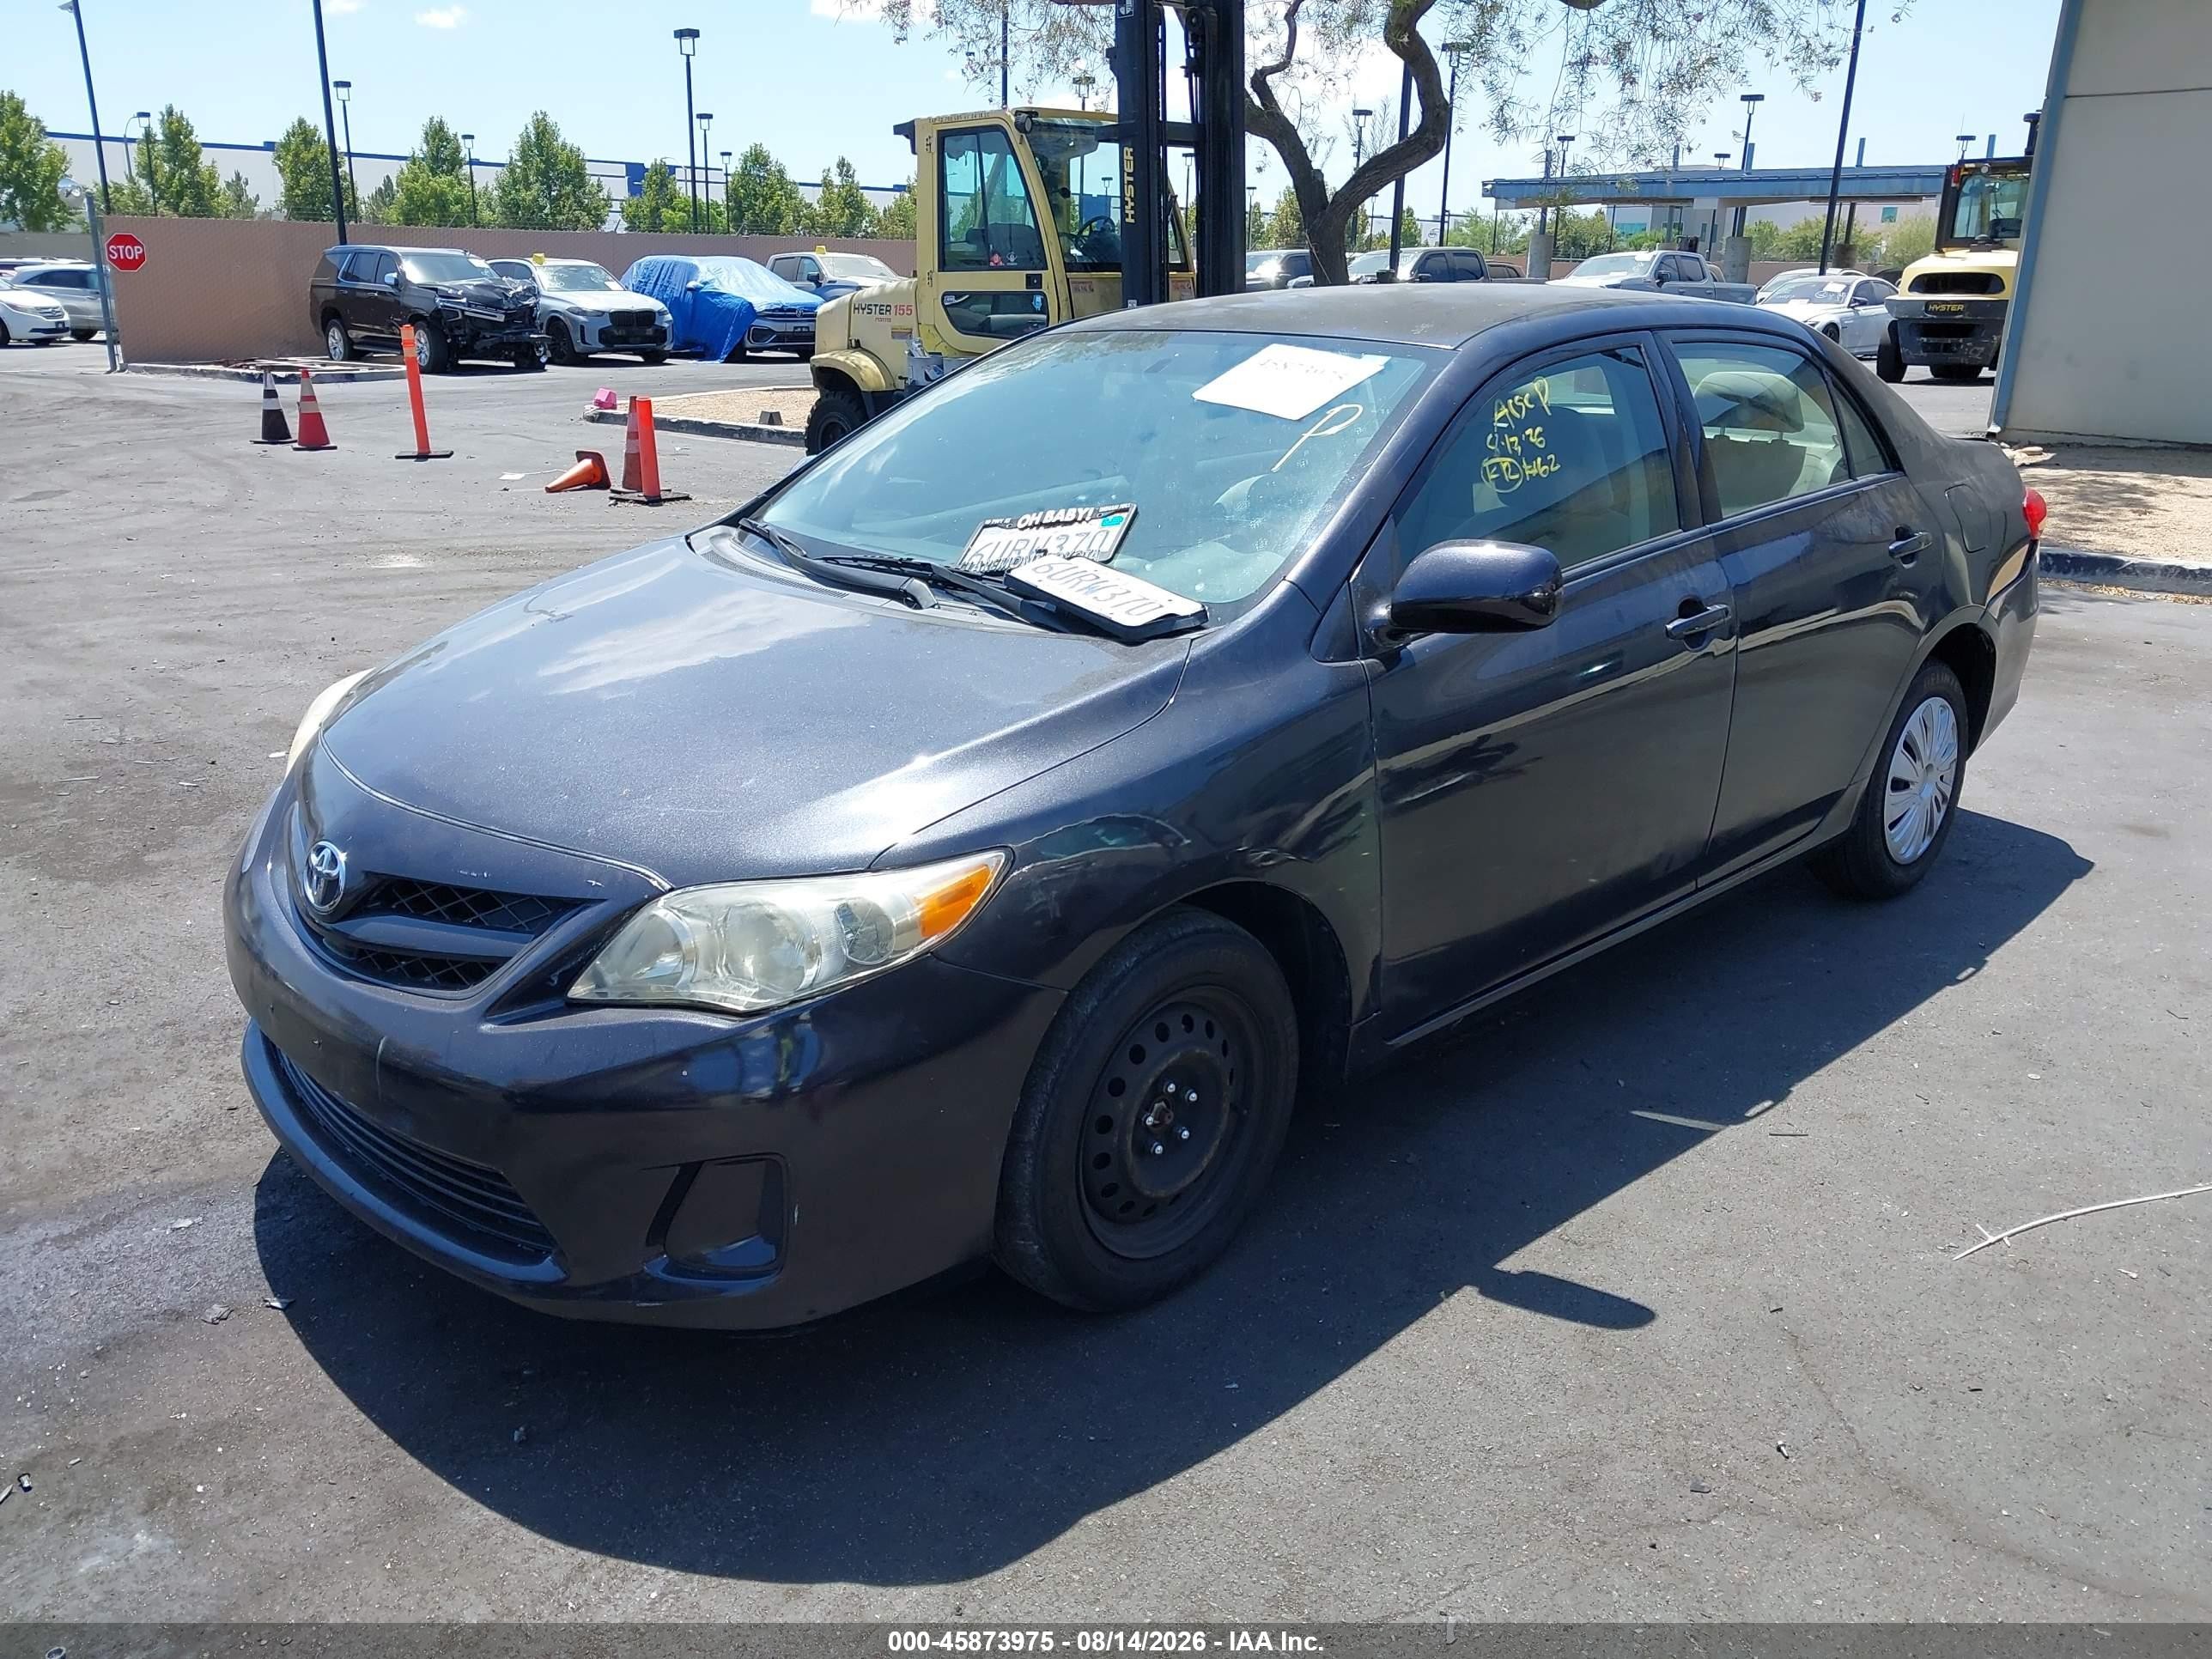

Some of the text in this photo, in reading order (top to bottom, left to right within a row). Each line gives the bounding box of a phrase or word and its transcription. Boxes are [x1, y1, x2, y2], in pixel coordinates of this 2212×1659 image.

[1123, 146, 1135, 224] HYSTER
[108, 245, 143, 260] STOP
[853, 302, 914, 316] HYSTER 155
[1928, 303, 1966, 312] HYSTER
[1017, 513, 1041, 531] OH
[1042, 507, 1096, 526] BABY!
[1031, 562, 1164, 617] 6URW370
